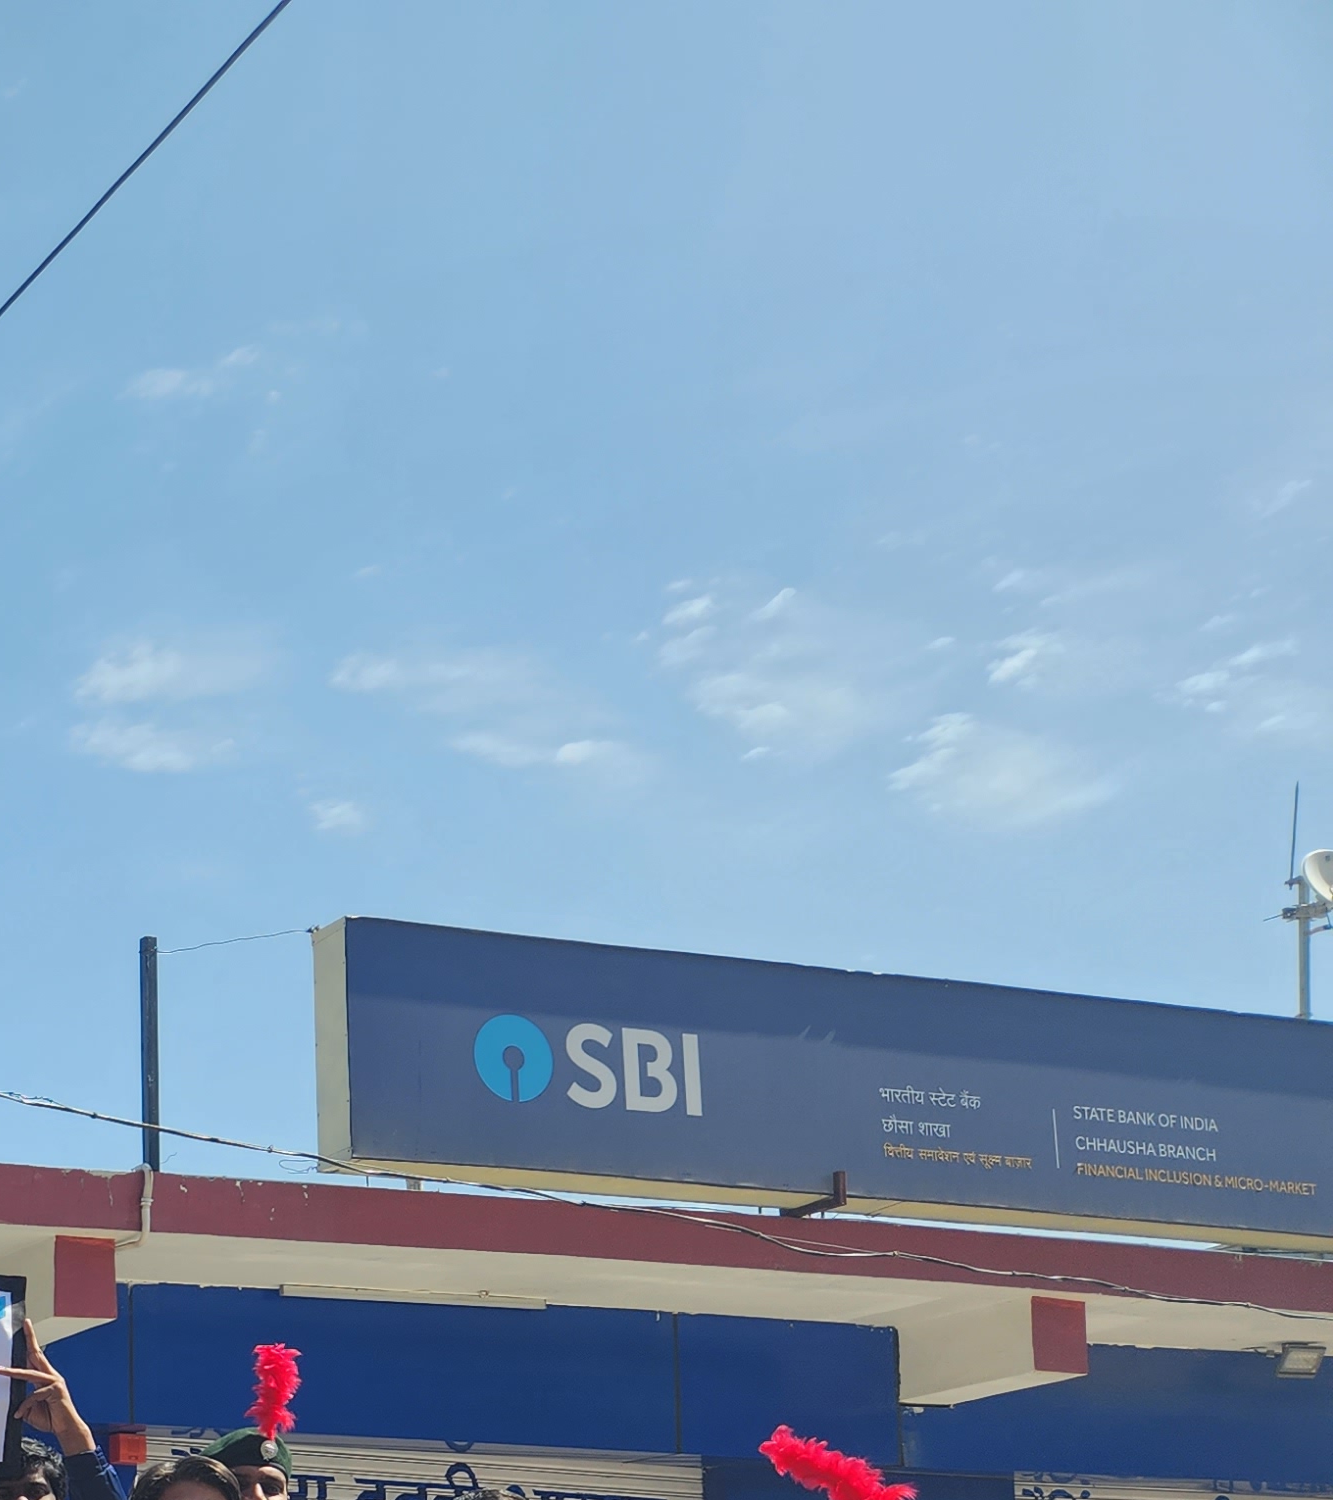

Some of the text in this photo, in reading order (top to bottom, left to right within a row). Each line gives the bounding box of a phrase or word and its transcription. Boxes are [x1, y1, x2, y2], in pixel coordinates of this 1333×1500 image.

[565, 1023, 703, 1117] SBI
[879, 1085, 981, 1110] भारतीय स्टेट बैंक
[918, 1121, 951, 1138] शाखा
[1073, 1105, 1219, 1132] STATE BANK OF INDIA
[1075, 1136, 1217, 1162] CHHAUSHA BRANCH
[1076, 1162, 1317, 1196] FINANCIAL INCLUSION & MICRO-MARKET
